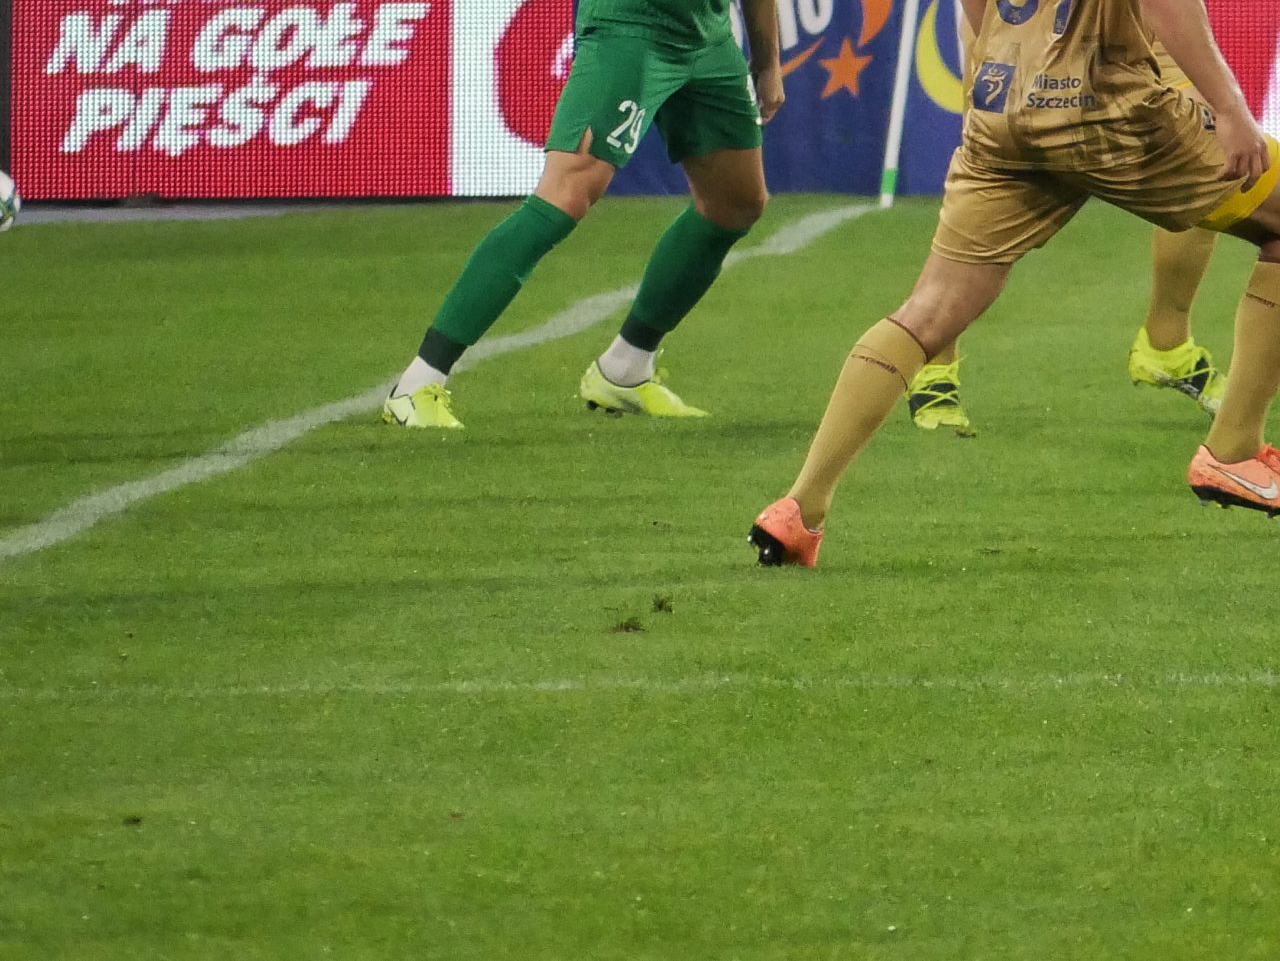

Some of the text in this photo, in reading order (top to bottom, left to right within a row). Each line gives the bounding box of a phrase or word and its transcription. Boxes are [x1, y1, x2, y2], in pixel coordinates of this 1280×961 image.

[46, 1, 431, 75] NA GOŁE
[1026, 91, 1097, 109] Szczecin
[1032, 73, 1082, 90] Miasto
[59, 71, 374, 157] PIĘŚCI
[606, 100, 646, 154] 29
